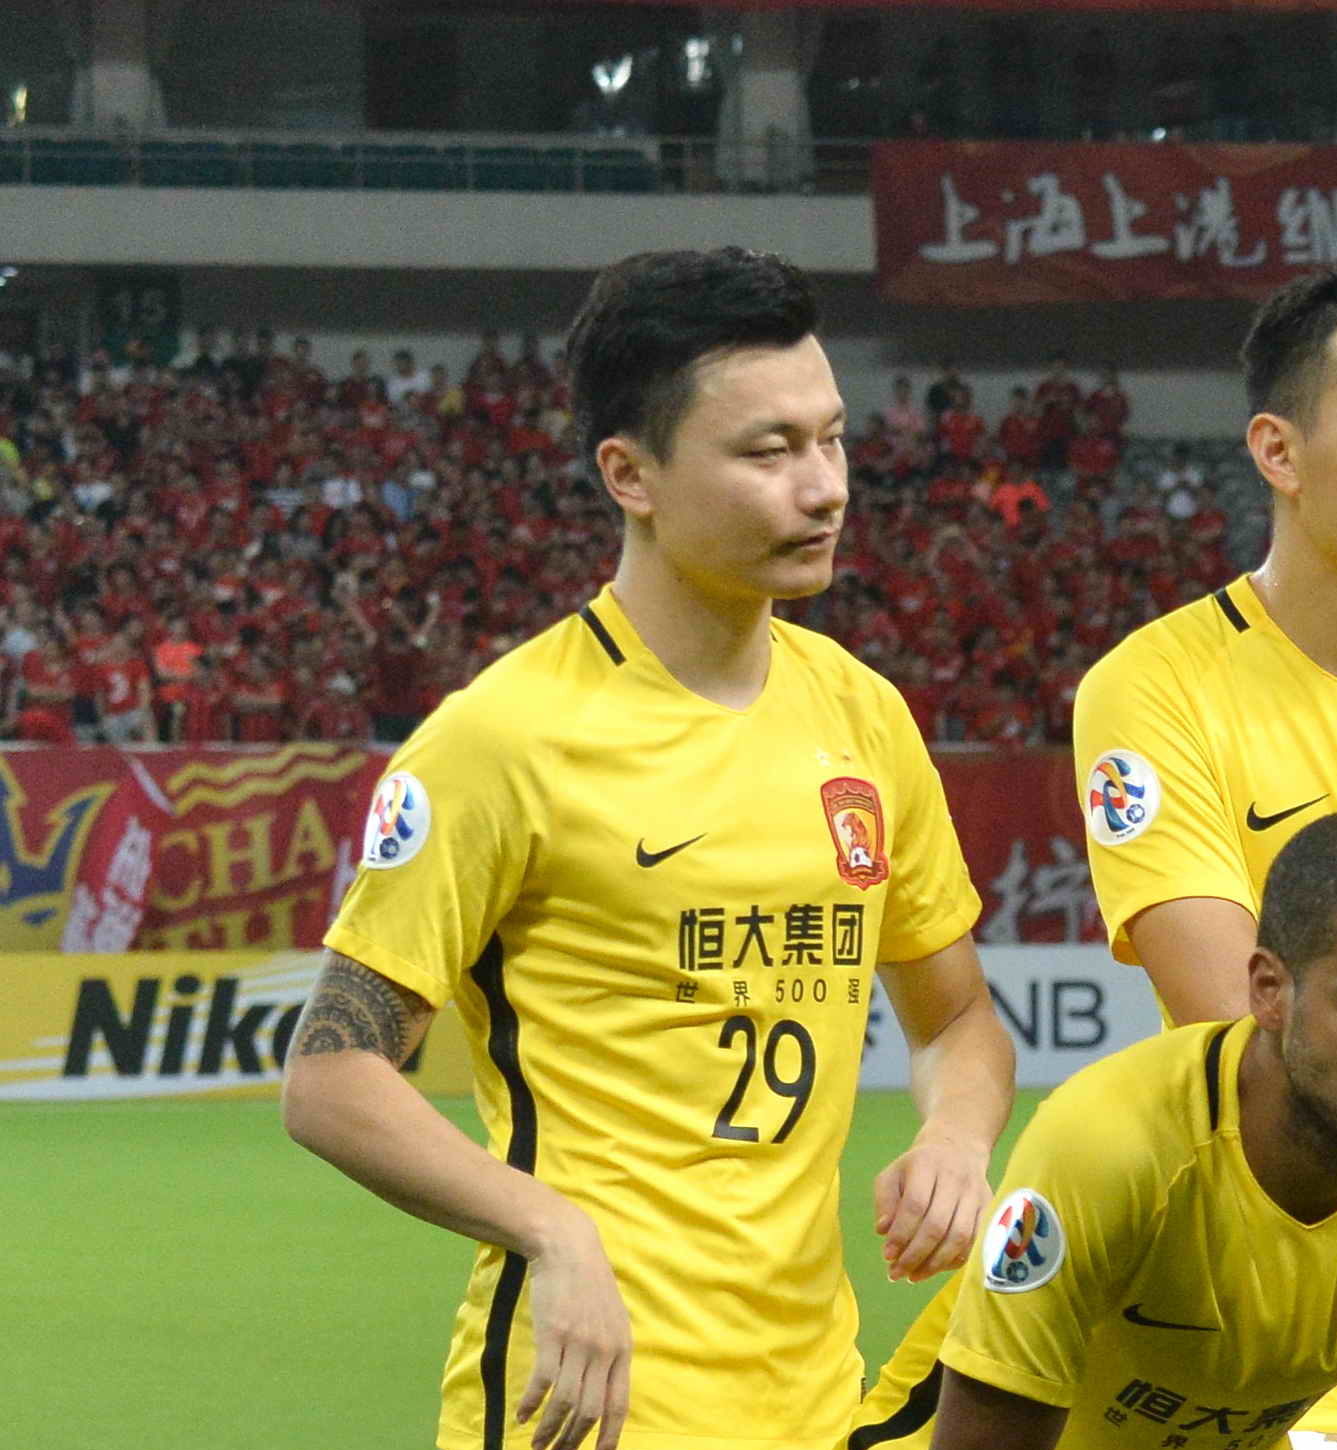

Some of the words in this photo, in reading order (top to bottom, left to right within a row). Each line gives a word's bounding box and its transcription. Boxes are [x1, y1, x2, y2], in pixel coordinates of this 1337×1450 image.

[151, 797, 337, 912] CHA
[678, 903, 865, 971] 恒大集团
[989, 979, 1107, 1051] NB
[711, 1014, 817, 1145] 29
